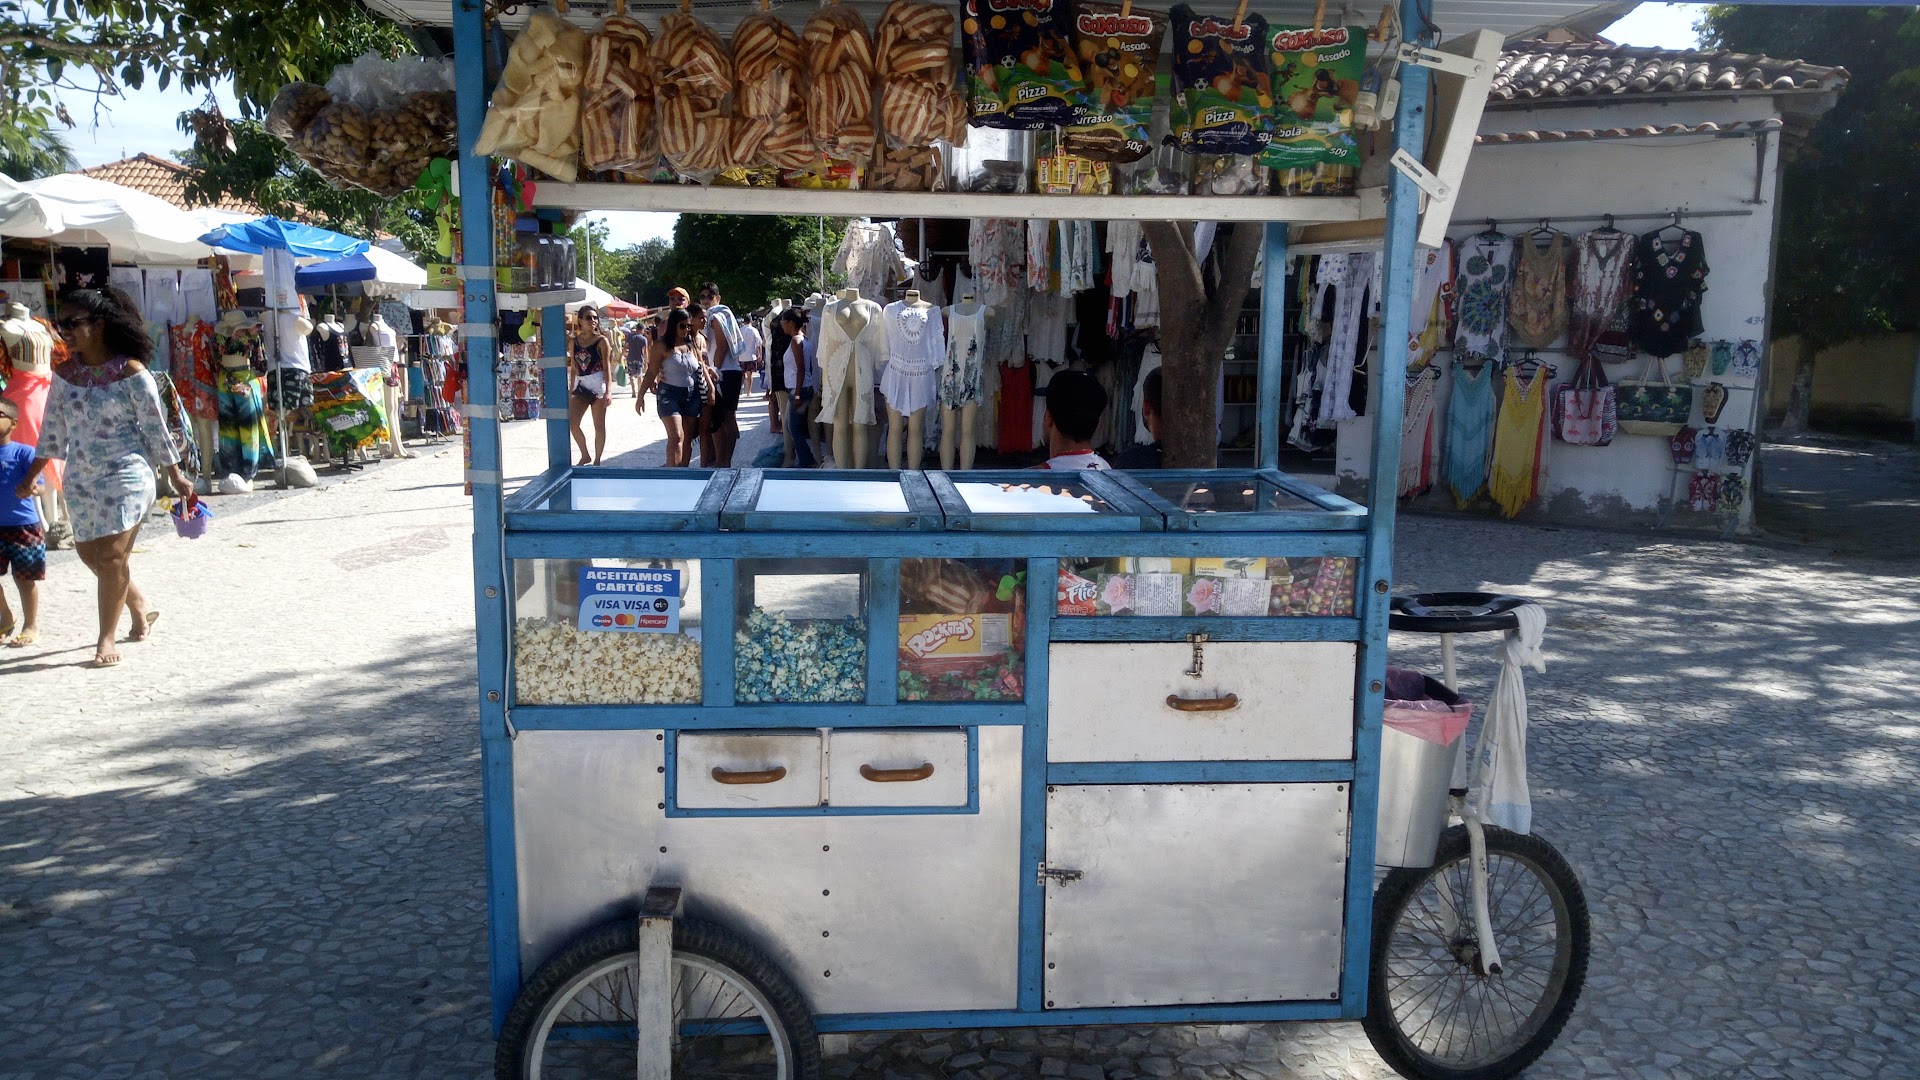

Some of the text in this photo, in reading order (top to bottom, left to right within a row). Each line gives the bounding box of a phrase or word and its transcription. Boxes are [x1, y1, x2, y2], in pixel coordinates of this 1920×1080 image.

[1120, 42, 1151, 52] Assado
[1317, 49, 1351, 62] Assado
[1017, 87, 1047, 101] Pizza
[1205, 111, 1235, 125] Pizza
[1125, 140, 1143, 154] 50g
[1329, 147, 1348, 158] 50g
[586, 570, 673, 582] ACEITAMOS
[595, 581, 664, 594] CARTÕES
[594, 600, 620, 609] VISA
[623, 600, 650, 610] VISA
[639, 617, 668, 626] Hipercard
